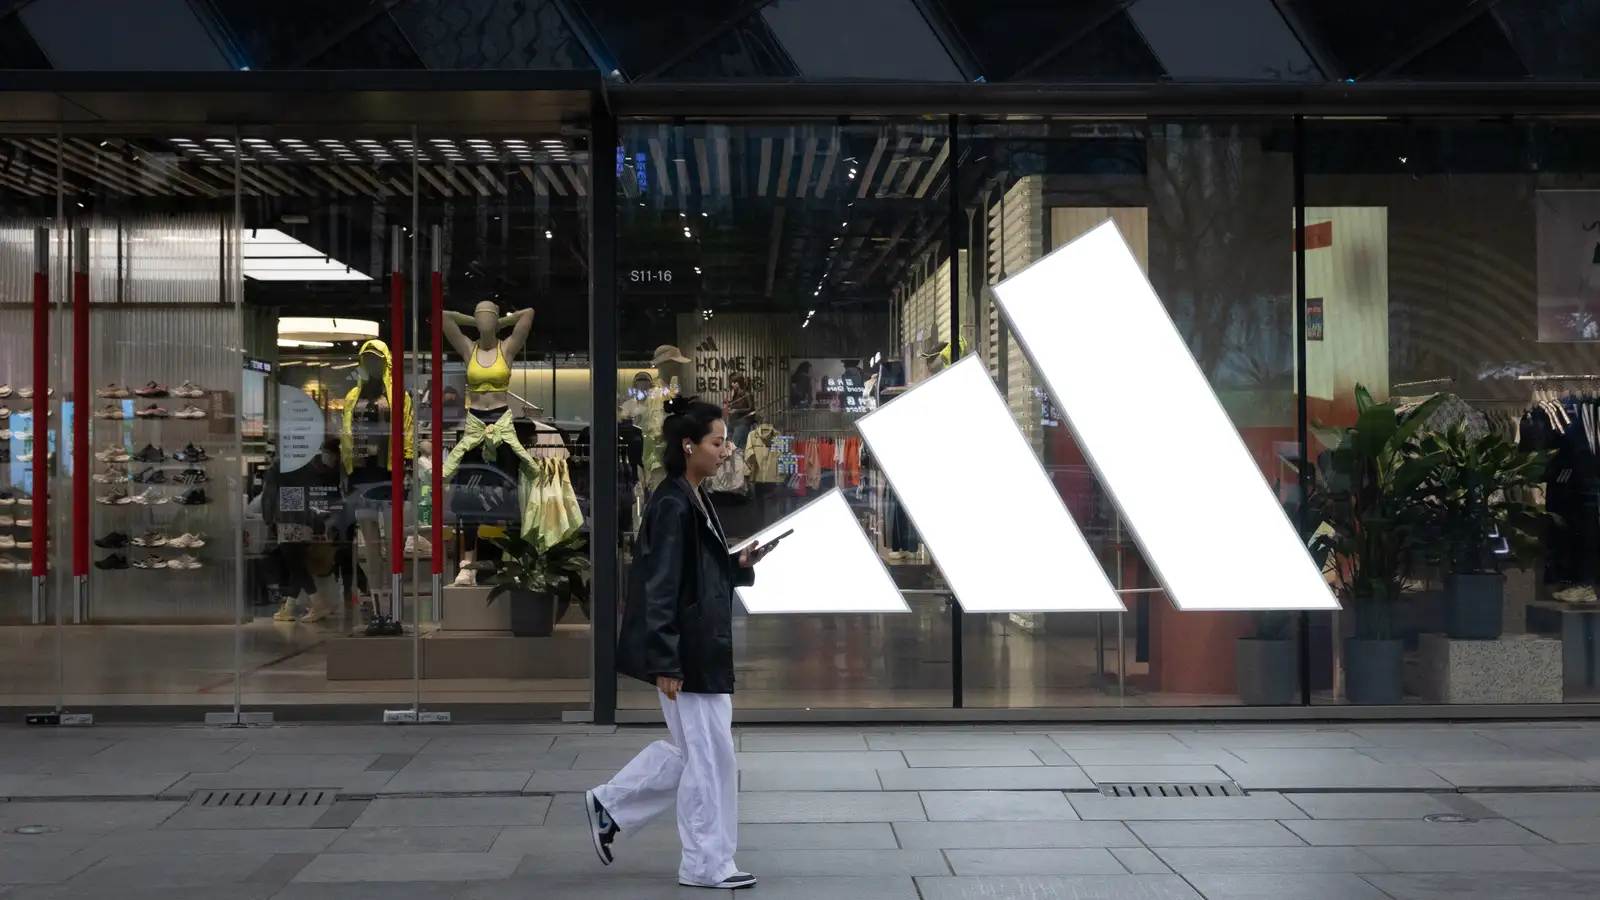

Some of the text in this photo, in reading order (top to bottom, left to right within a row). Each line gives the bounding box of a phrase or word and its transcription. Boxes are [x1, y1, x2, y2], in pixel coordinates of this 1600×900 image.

[630, 269, 672, 282] S11-16
[695, 356, 746, 372] HOME
[751, 356, 776, 372] OF
